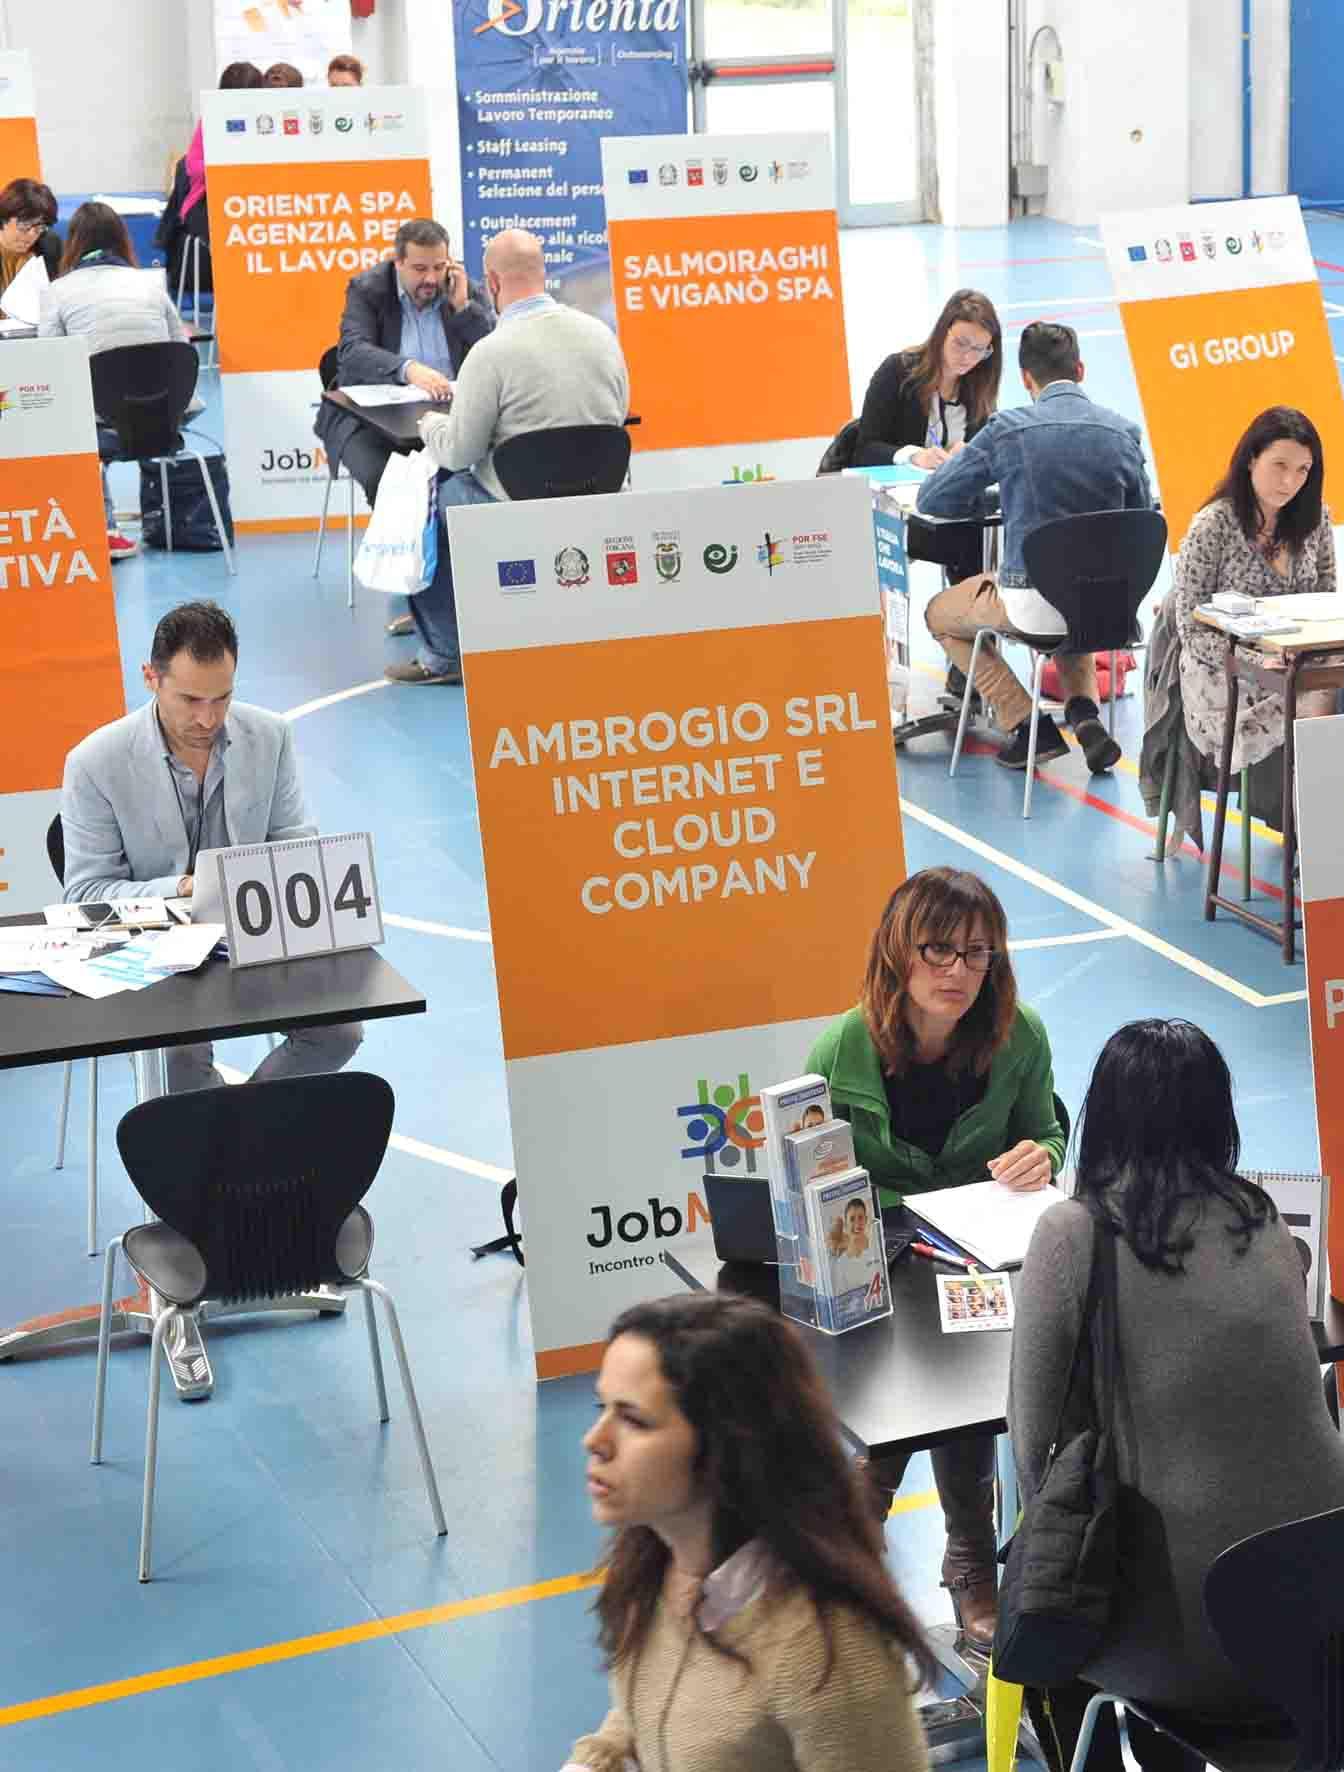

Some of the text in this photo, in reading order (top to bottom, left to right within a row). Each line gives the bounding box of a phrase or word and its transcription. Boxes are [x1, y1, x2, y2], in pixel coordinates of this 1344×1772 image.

[488, 0, 681, 35] Orienta
[475, 88, 598, 105] Somministrazione
[477, 107, 614, 124] Lavoro Temporaneo
[477, 138, 568, 157] Staff Leasing
[478, 166, 553, 181] Permanent
[224, 191, 416, 218] ORIENTA SPA
[478, 183, 543, 199] Selezione
[546, 181, 568, 196] del
[225, 219, 402, 246] AGENZIA PE
[480, 212, 577, 231] Outplacement
[246, 252, 272, 274] IL
[624, 244, 828, 280] SALMOIRAGHI
[625, 275, 833, 311] E VIGANÒ SPA
[1169, 329, 1295, 369] GI GROUP
[0, 549, 99, 589] TIVA
[489, 692, 877, 768] AMBROGIO SRL
[552, 748, 825, 815] INTERNET E
[613, 806, 776, 860] CLOUD
[581, 852, 816, 915] COMPANY
[236, 863, 372, 937] 004
[589, 1254, 655, 1275] Incontro
